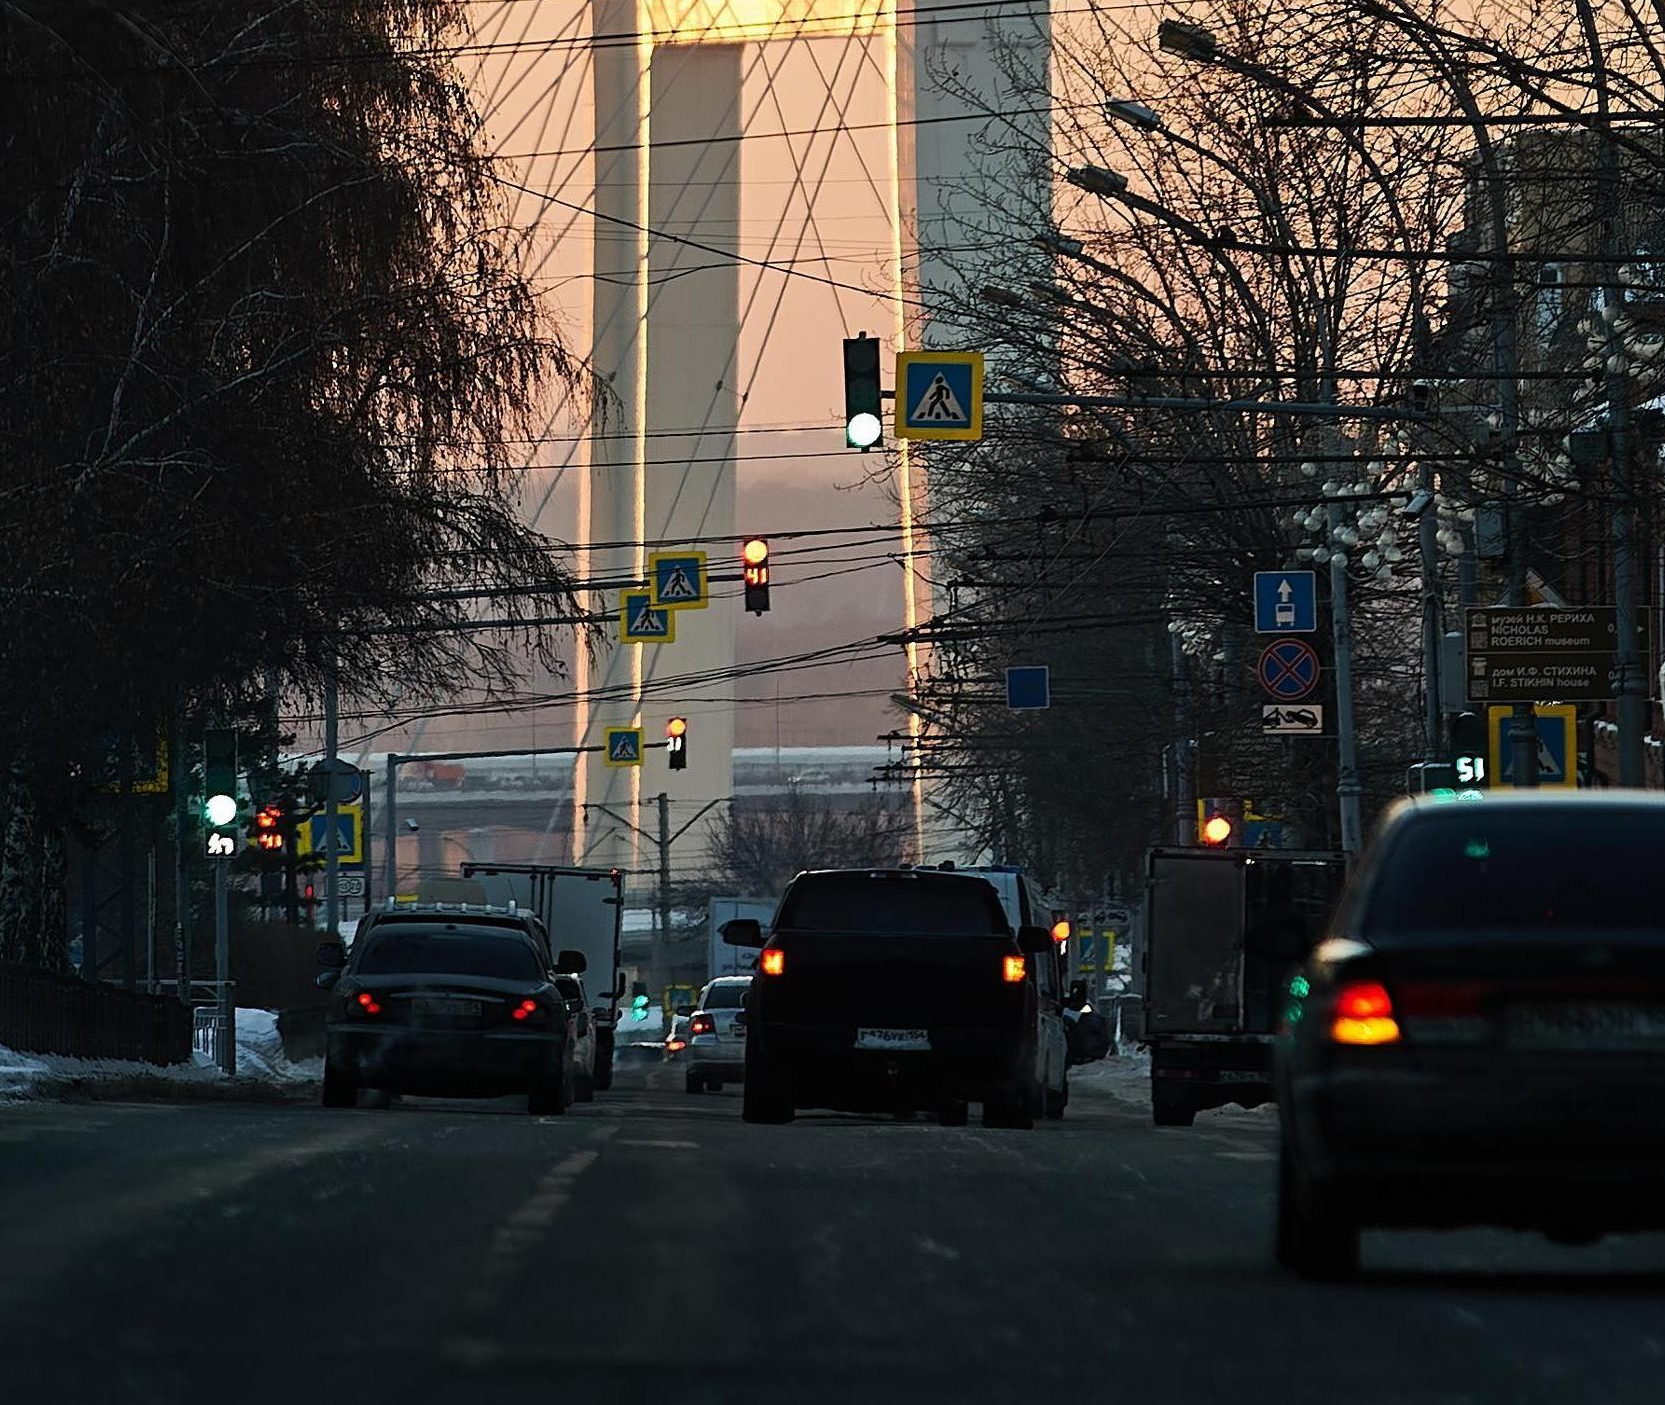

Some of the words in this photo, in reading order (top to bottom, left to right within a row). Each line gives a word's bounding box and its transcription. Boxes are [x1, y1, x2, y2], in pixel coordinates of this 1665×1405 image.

[747, 568, 767, 585] 41
[1550, 613, 1596, 623] РЕРИХА
[1491, 625, 1549, 635] NICHOLAS
[1491, 636, 1543, 647] ROERICH
[1544, 637, 1590, 646] museum
[1543, 666, 1597, 676] СТИХИНА
[1556, 677, 1590, 687] house
